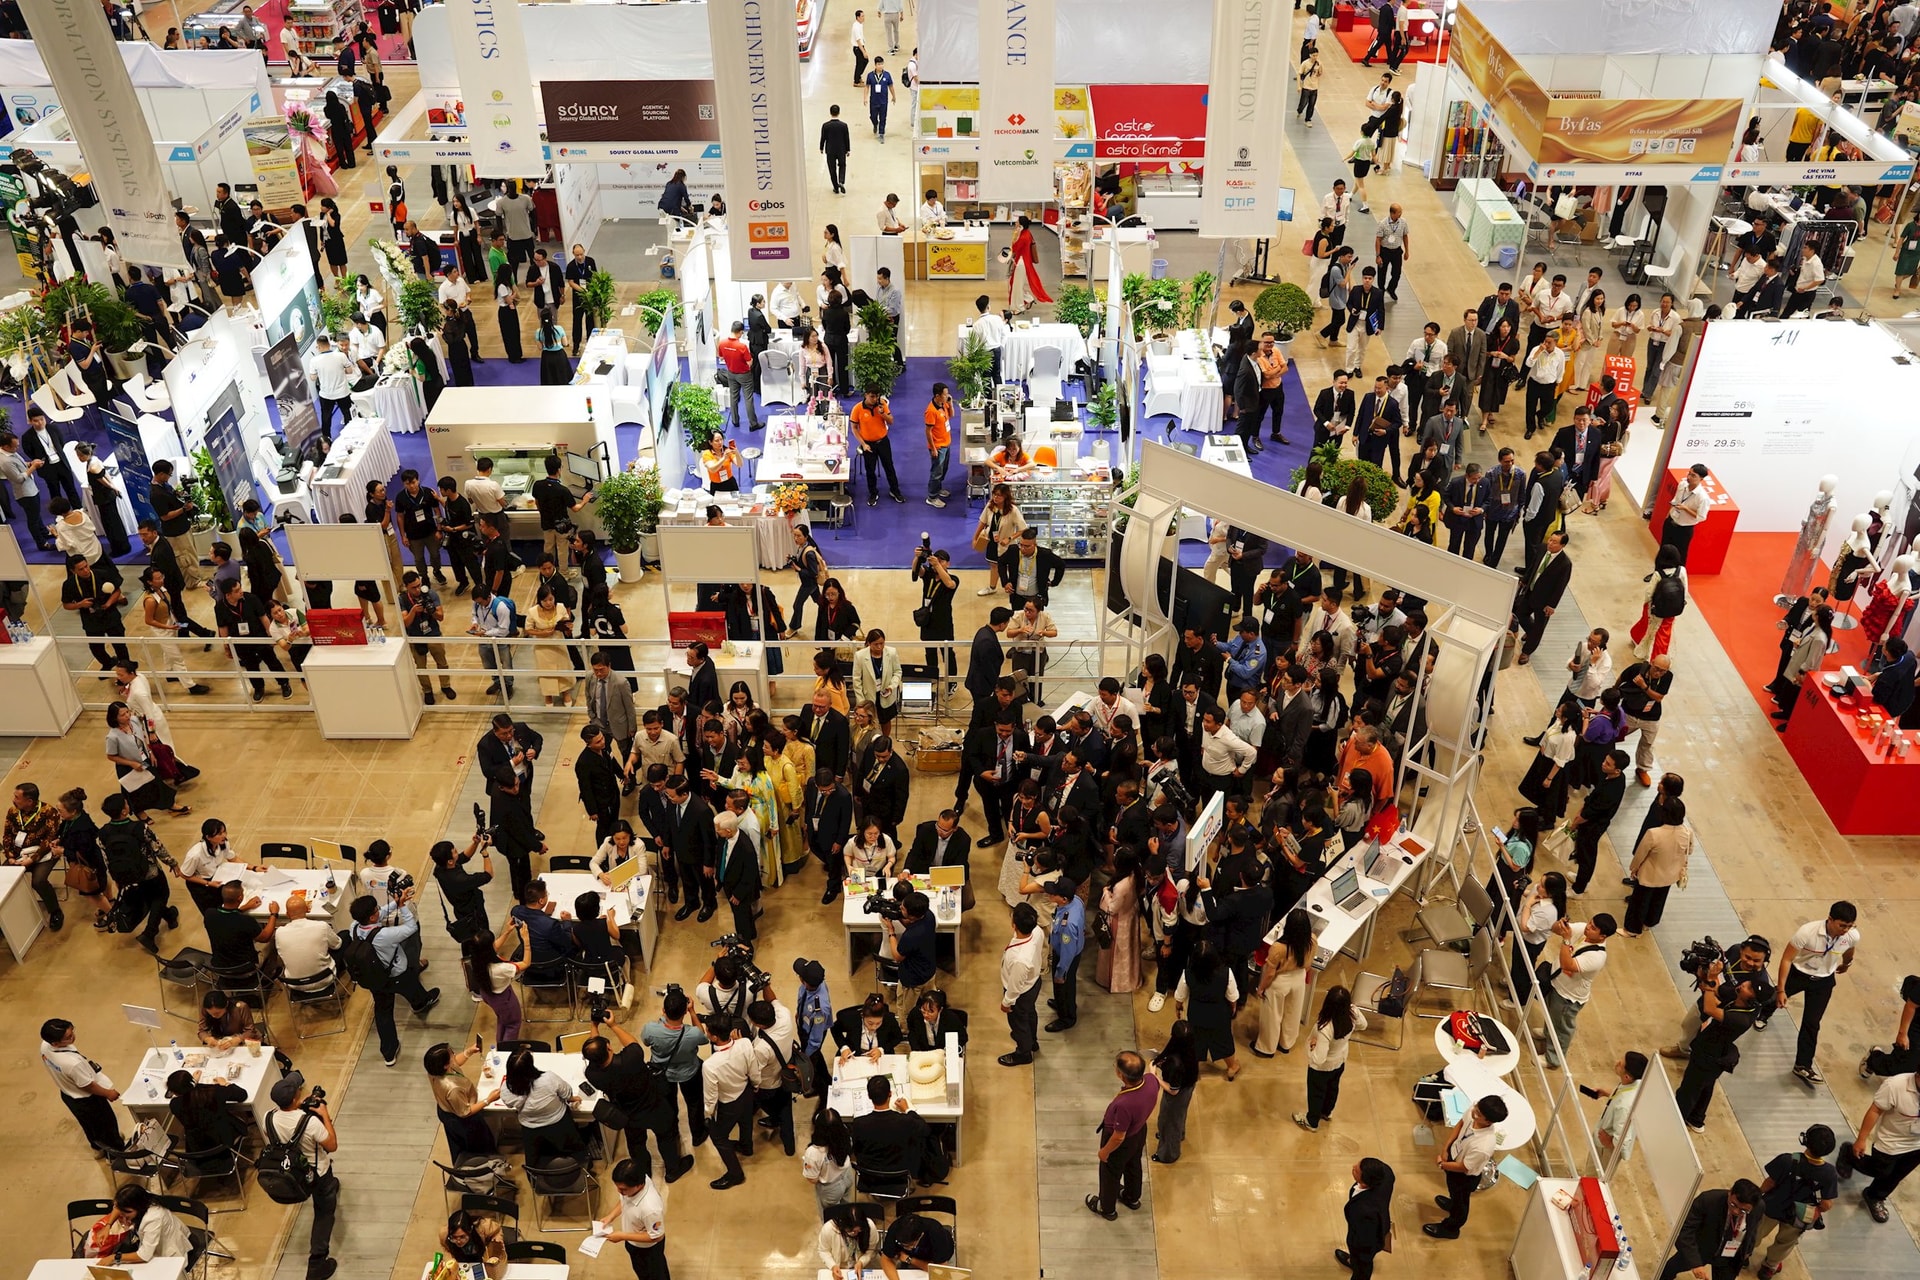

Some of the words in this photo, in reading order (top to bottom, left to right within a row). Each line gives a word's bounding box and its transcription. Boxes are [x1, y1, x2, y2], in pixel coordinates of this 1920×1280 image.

[557, 103, 618, 117] SOURCY
[1114, 118, 1155, 132] astro
[1560, 116, 1602, 135] Byfas
[751, 92, 774, 191] SUPPLIERS
[1107, 143, 1140, 155] astro
[1142, 142, 1183, 155] farmer
[1224, 197, 1255, 208] QTIP
[1733, 401, 1756, 409] 56%
[1687, 439, 1709, 448] 89%
[1714, 439, 1746, 448] 29.5%
